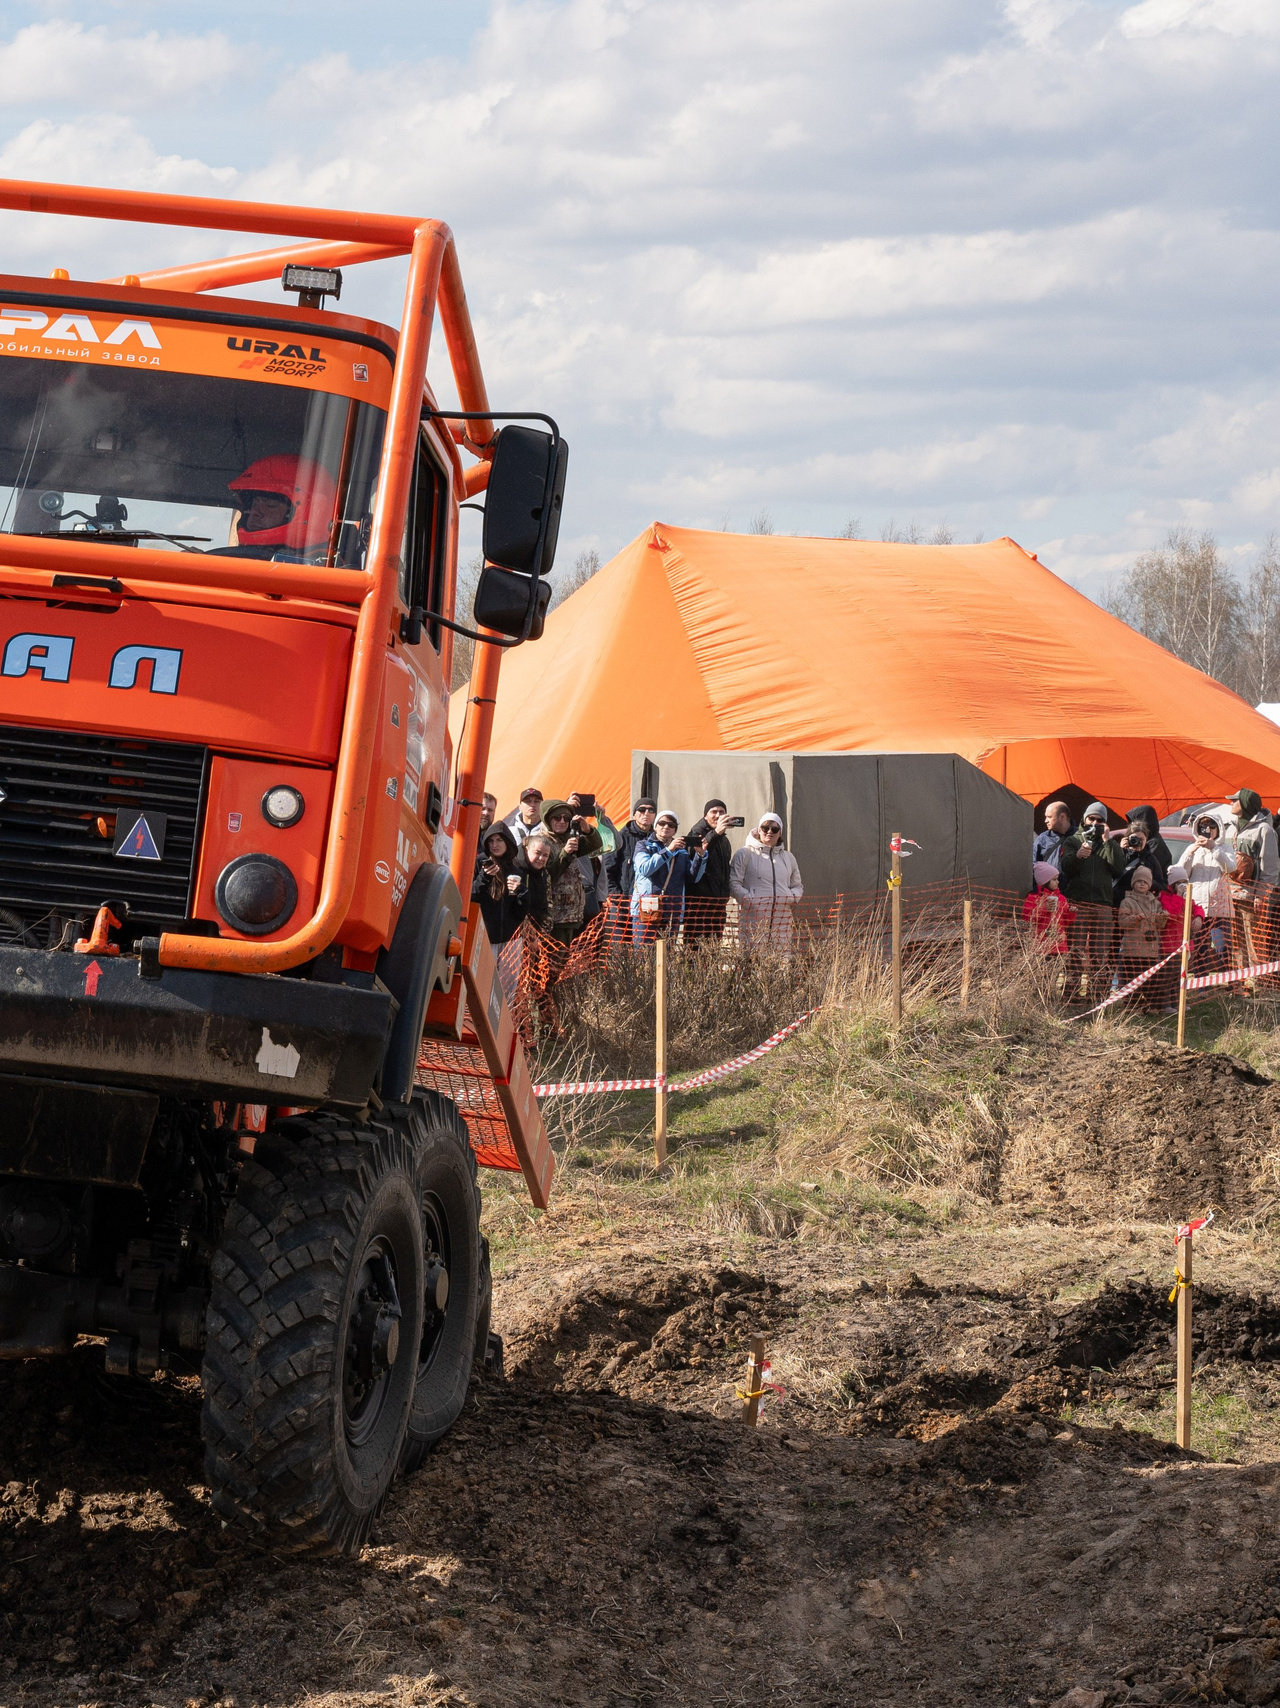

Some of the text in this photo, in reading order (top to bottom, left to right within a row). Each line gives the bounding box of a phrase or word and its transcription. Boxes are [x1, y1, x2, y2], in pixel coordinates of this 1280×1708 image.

[227, 337, 327, 363] URAL
[101, 351, 161, 366] завод
[269, 358, 327, 373] MOTOR
[263, 365, 318, 378] SPORT
[375, 865, 390, 880] SINTEC
